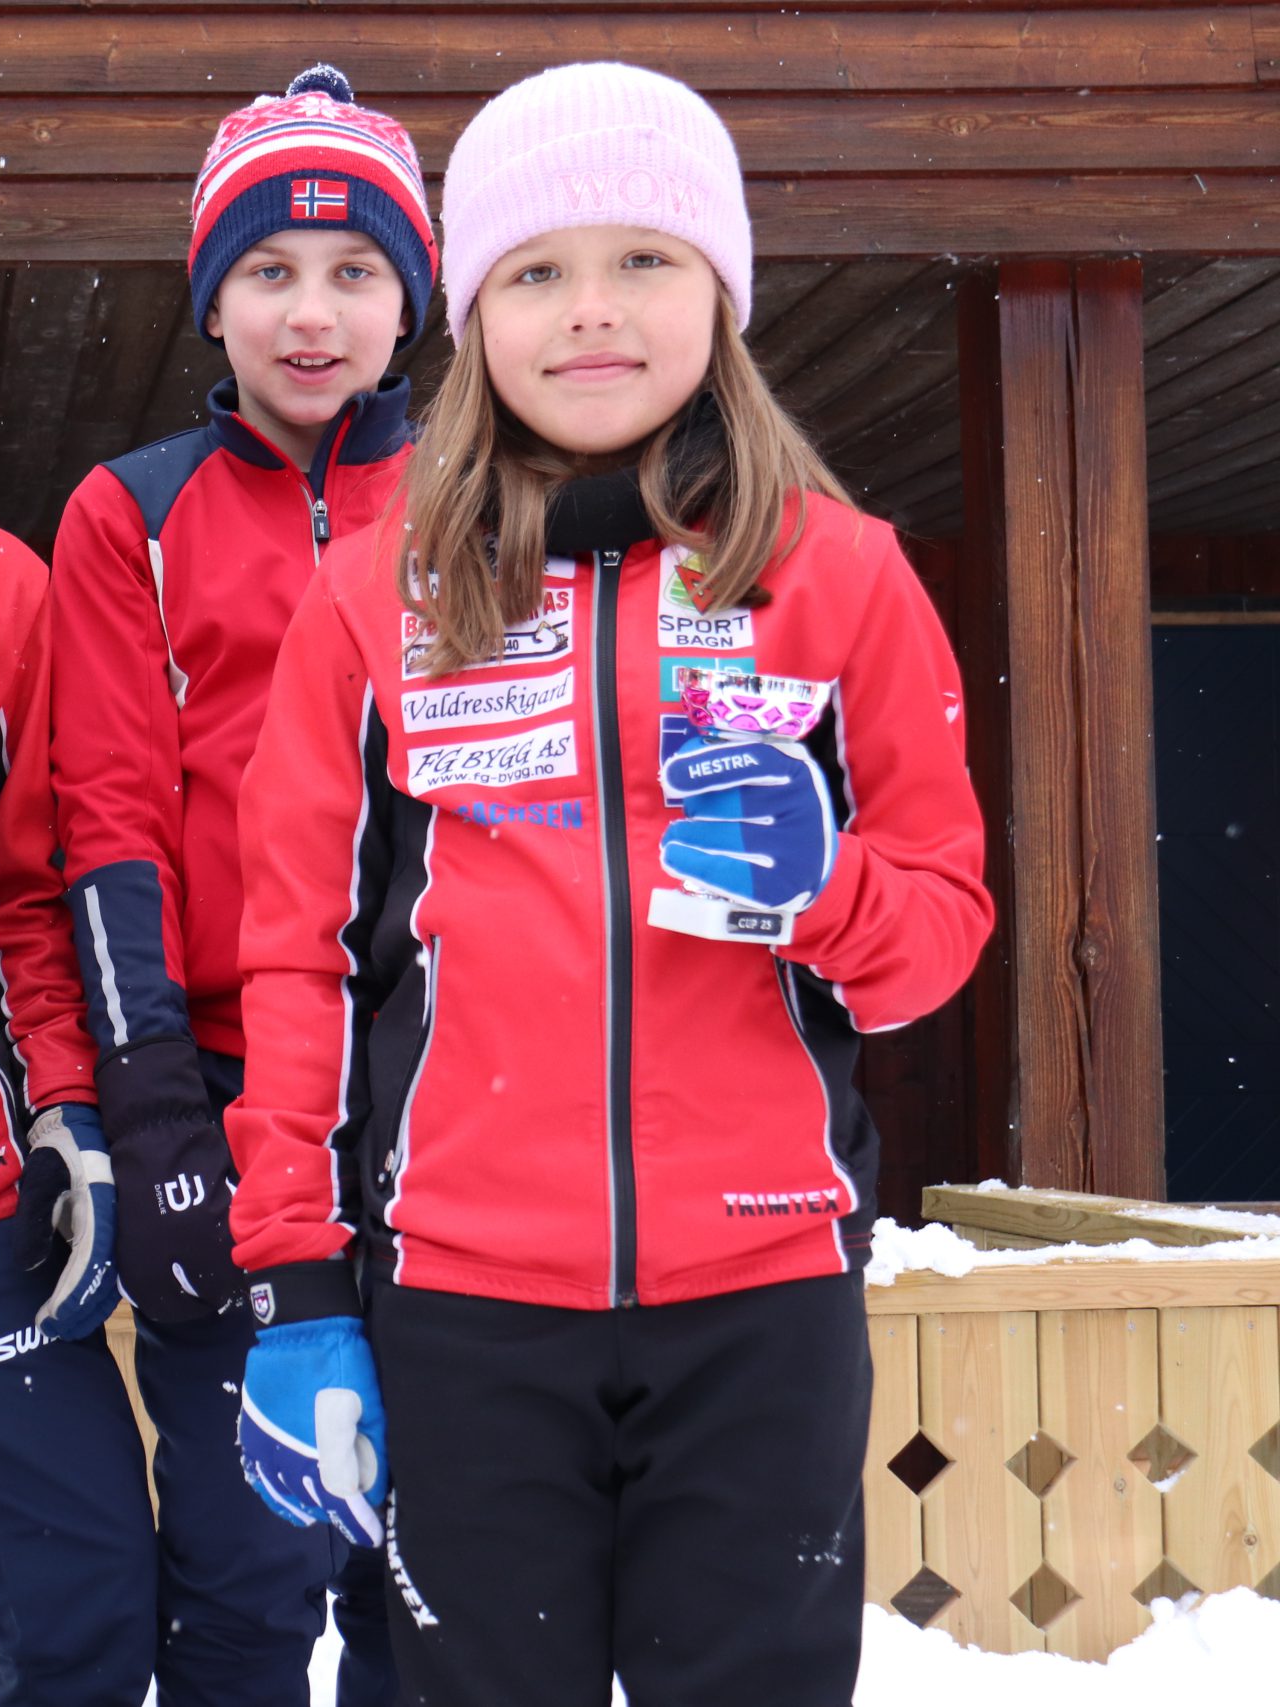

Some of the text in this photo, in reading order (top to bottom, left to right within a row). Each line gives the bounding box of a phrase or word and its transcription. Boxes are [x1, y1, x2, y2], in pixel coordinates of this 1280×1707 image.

[559, 168, 704, 220] WOW
[543, 591, 569, 615] AS
[659, 614, 748, 634] SPORT
[676, 635, 733, 648] BAGN
[404, 671, 572, 722] Valdresskigard
[411, 735, 571, 780] FG BYGG AS
[688, 753, 760, 779] HESTRA
[428, 764, 554, 786] www.fg-bygg.no
[722, 1188, 839, 1216] TRIMTEX
